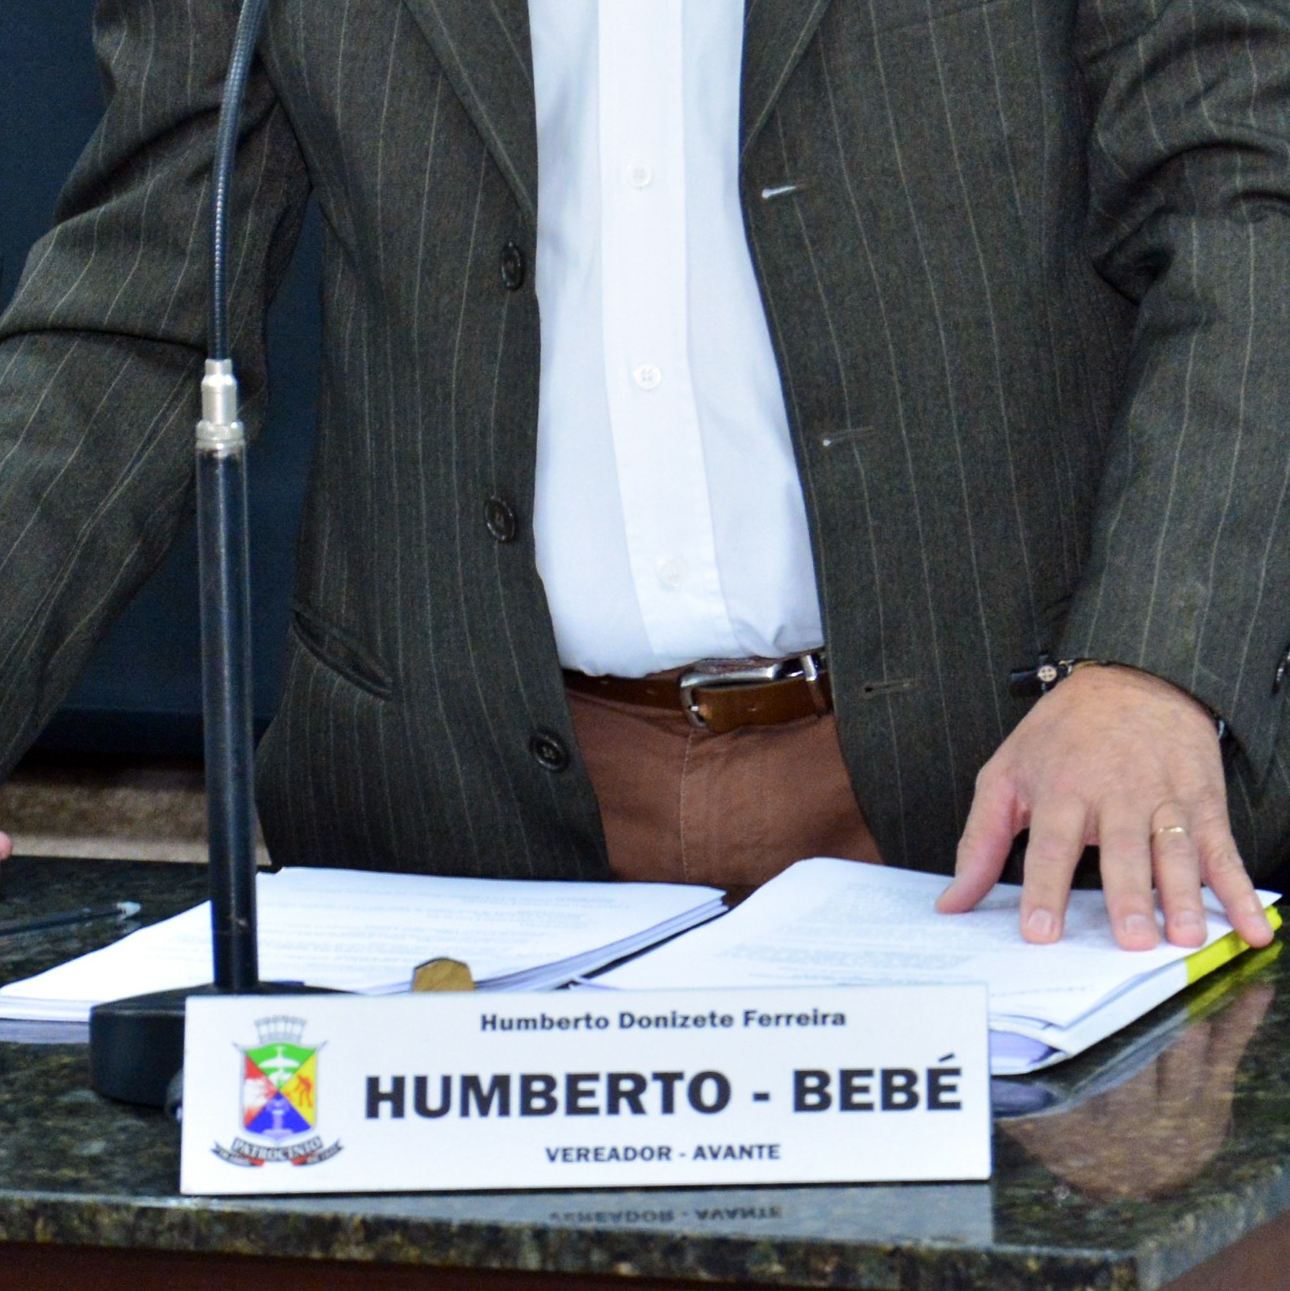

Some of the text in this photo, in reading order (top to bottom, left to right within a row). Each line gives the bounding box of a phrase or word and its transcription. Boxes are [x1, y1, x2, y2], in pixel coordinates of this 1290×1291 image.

[480, 1007, 847, 1032] Humberto Donizete Ferreira
[365, 1052, 962, 1120] HUMBERTO - BEBÉ
[545, 1145, 672, 1163] VEREADOR
[692, 1143, 780, 1161] AVANTE
